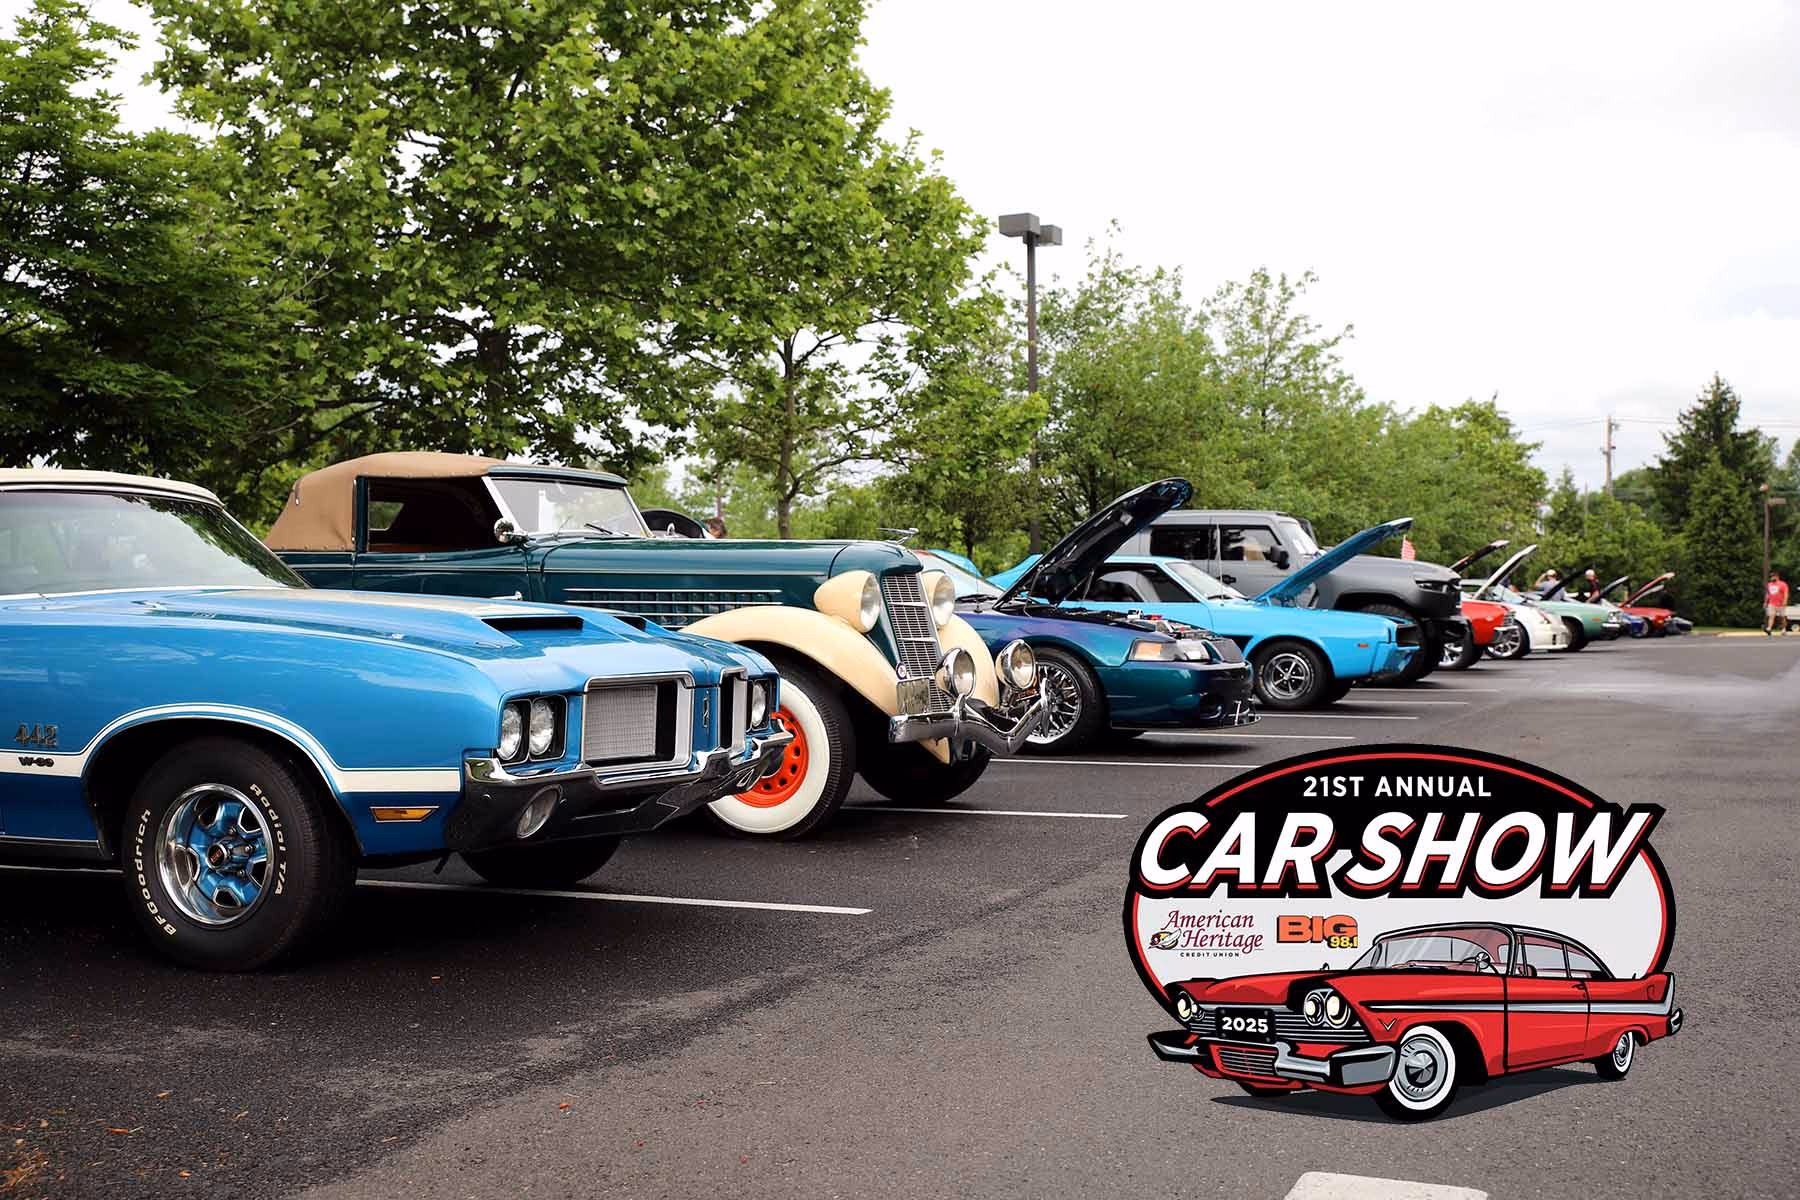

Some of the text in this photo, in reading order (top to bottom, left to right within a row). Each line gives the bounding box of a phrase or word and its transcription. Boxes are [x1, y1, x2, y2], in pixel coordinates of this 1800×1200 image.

[16, 723, 57, 746] 442
[134, 809, 177, 936] BFGoodrich
[249, 783, 287, 895] Radial T/A
